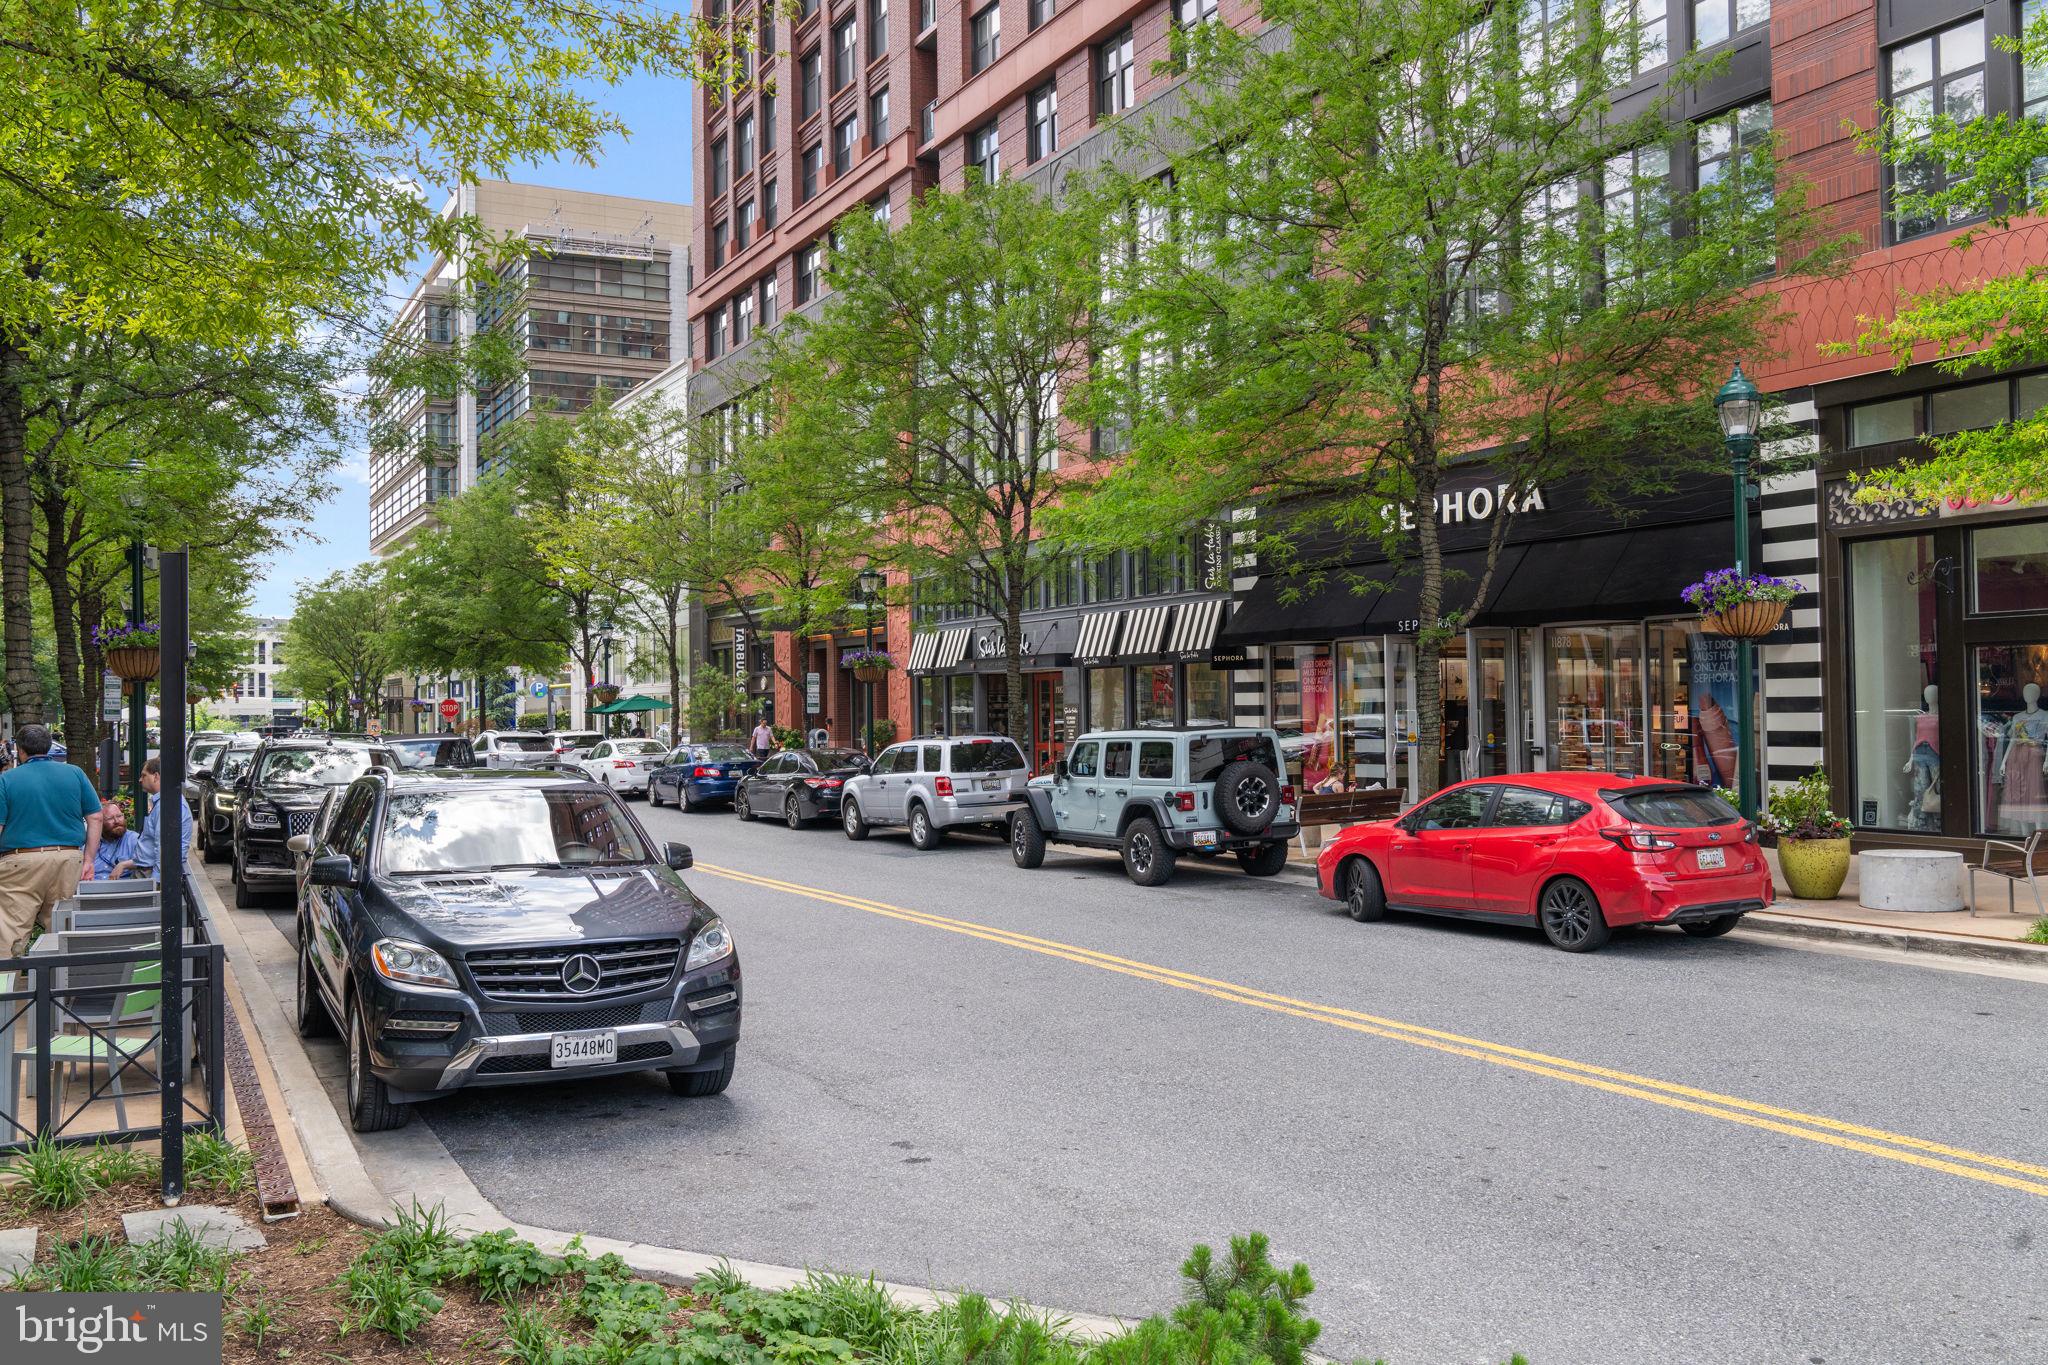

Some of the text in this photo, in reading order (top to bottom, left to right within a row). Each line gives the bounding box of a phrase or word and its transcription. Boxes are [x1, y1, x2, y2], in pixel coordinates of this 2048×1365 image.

[1397, 617, 1452, 632] SEPRA
[978, 635, 996, 658] Sur
[1693, 641, 1713, 651] JUST
[735, 627, 746, 694] TARBUCKS
[1213, 654, 1244, 662] SEPHORA
[1693, 648, 1738, 661] MUST HAV
[1693, 661, 1730, 673] ONLY AT
[535, 682, 544, 692] P
[441, 704, 458, 713] STOP
